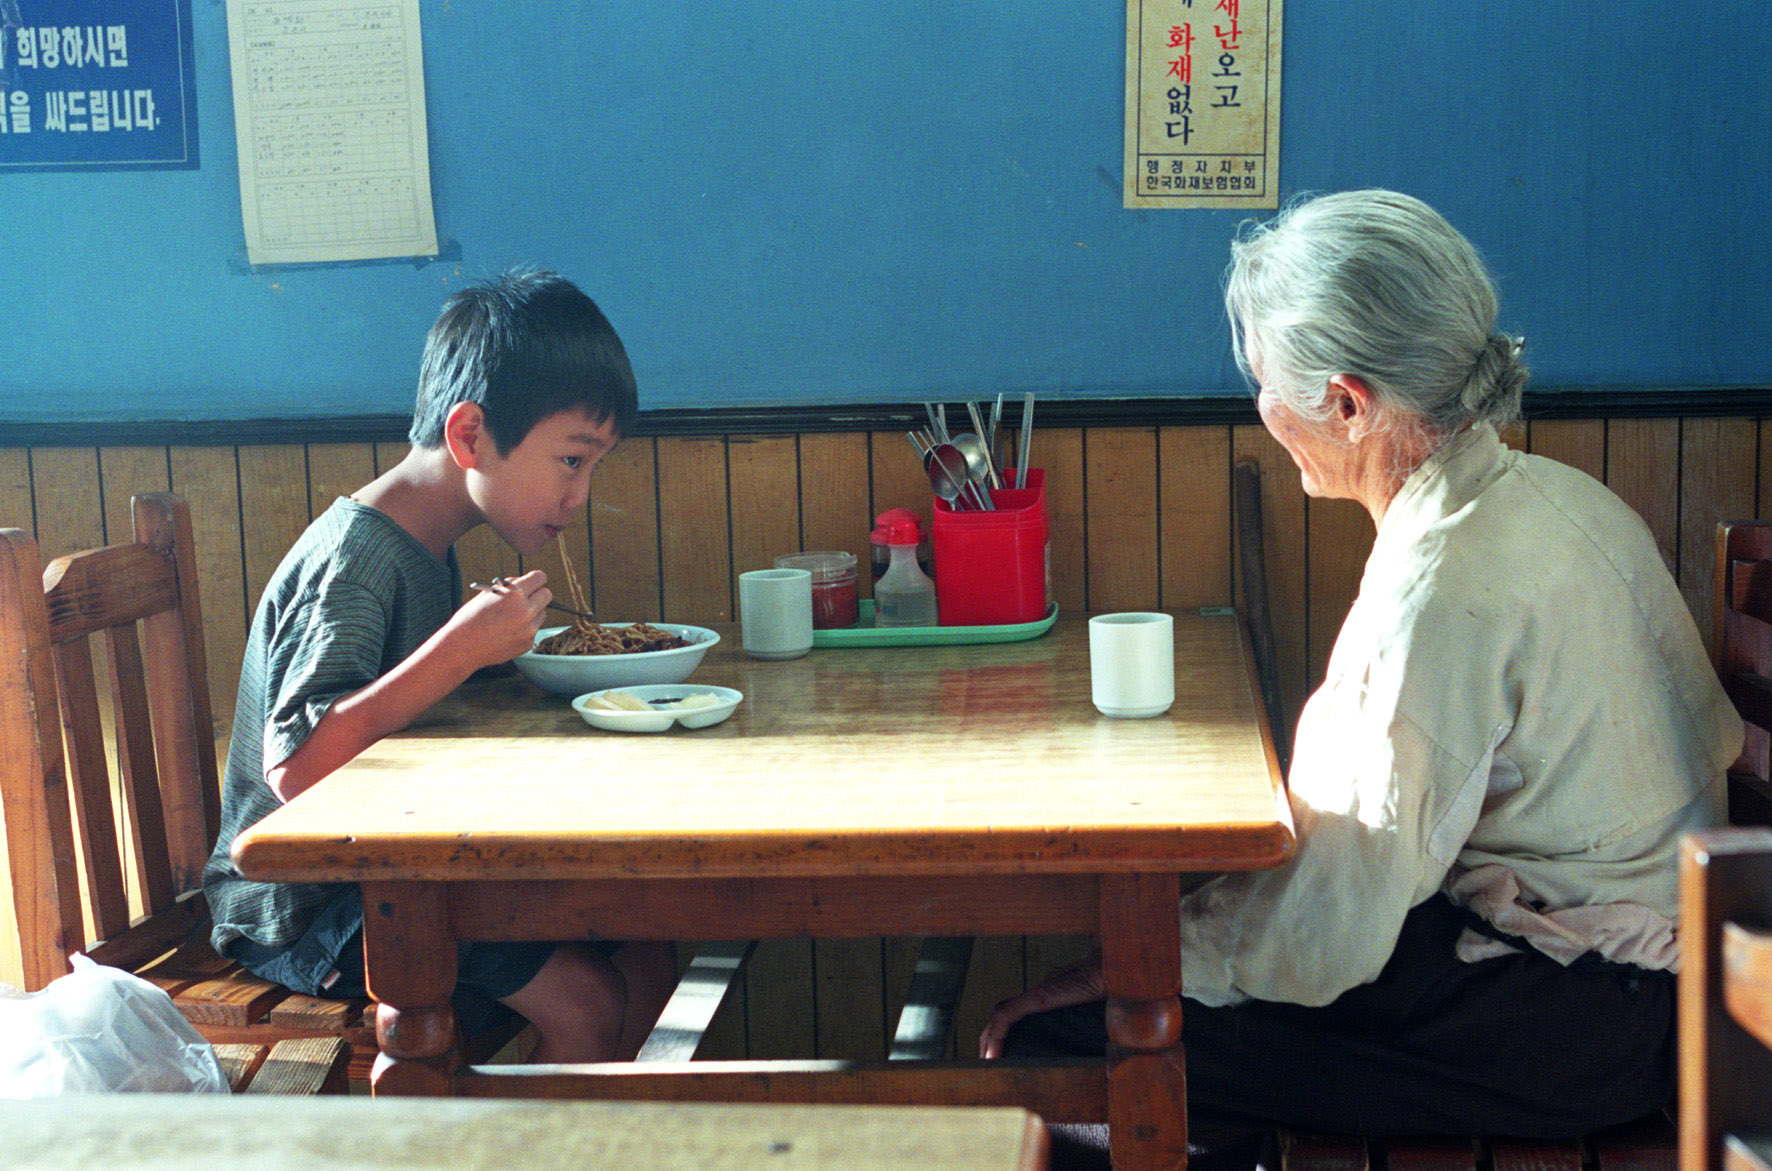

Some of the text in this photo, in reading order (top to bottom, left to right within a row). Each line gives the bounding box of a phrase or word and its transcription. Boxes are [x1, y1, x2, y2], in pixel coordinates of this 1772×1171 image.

[16, 25, 128, 69] 희망하시면
[44, 89, 161, 133] 싸드립니다.
[1146, 175, 1256, 190] 한국화재보험협회
